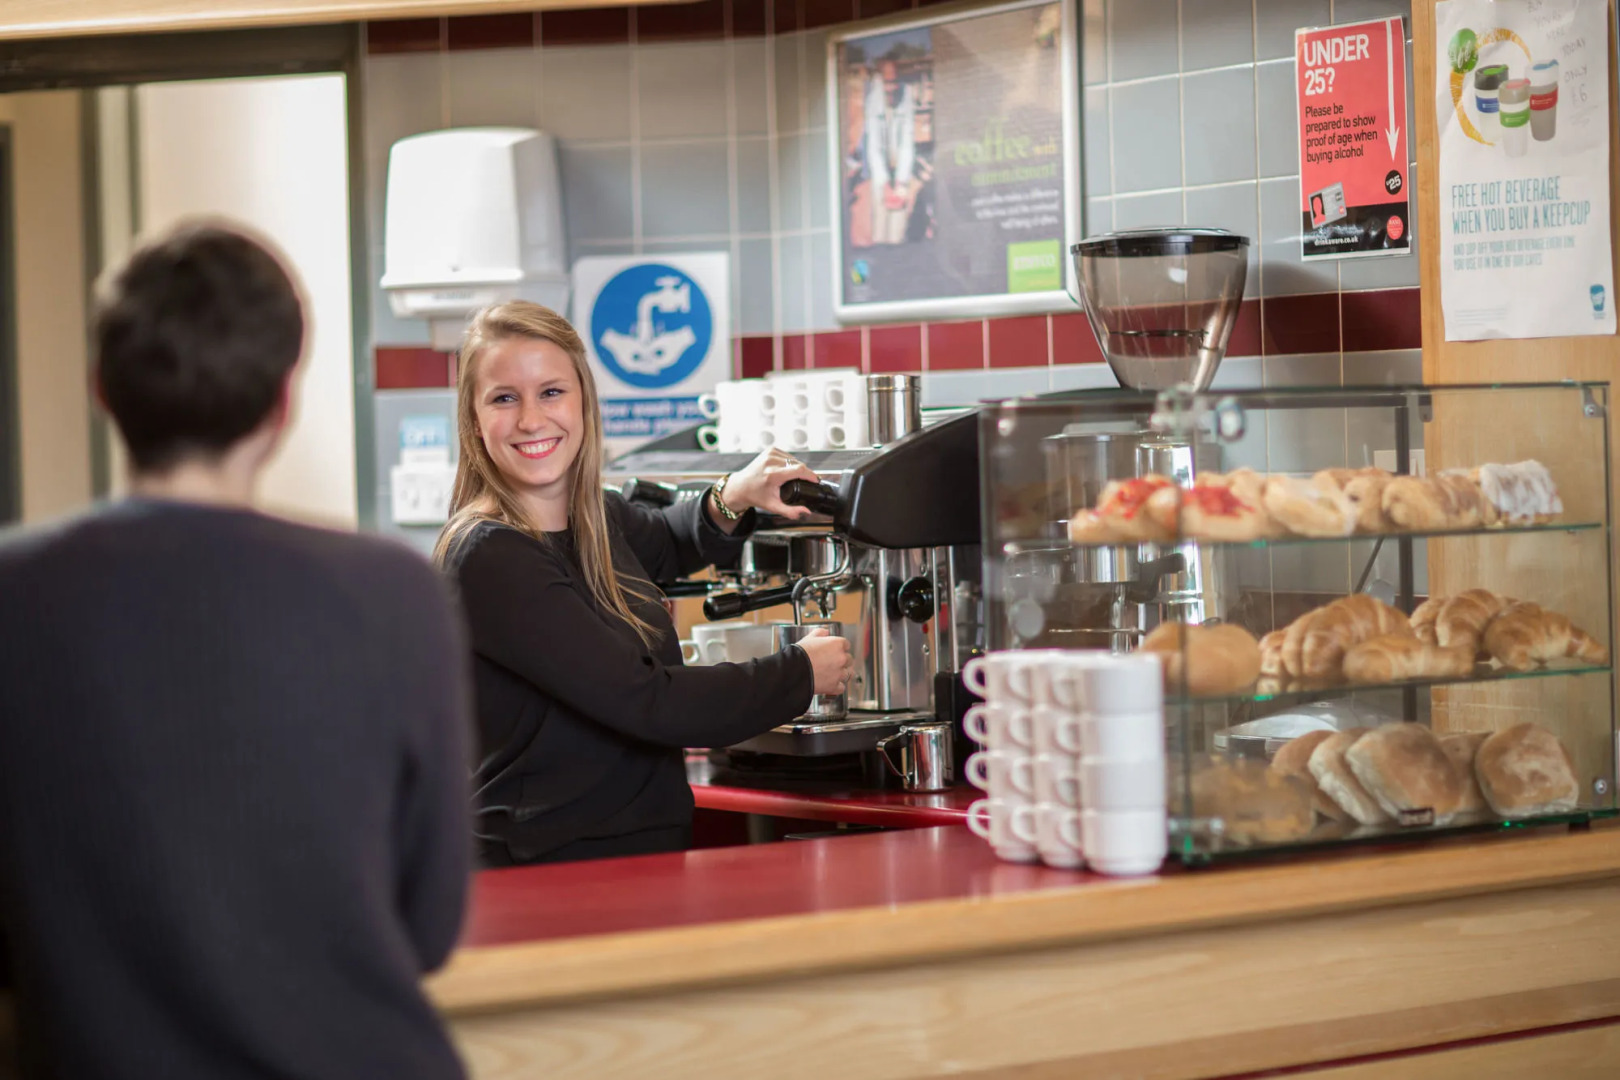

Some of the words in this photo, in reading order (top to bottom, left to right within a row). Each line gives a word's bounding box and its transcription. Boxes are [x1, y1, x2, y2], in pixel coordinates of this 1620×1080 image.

[1304, 33, 1370, 67] UNDER
[1305, 67, 1335, 96] 25?
[1305, 105, 1332, 118] Please
[1333, 103, 1344, 114] be
[1306, 117, 1341, 134] prepared
[1343, 118, 1351, 129] to
[1352, 115, 1376, 127] show
[1306, 131, 1327, 148] proof
[1328, 131, 1337, 145] of
[1337, 134, 1353, 147] age
[1354, 130, 1378, 142] when
[1306, 147, 1333, 164] buying
[1334, 145, 1364, 160] alcohol
[1452, 183, 1477, 209] FREE
[1481, 181, 1501, 206] HOT
[1505, 176, 1561, 204] BEVERAGE
[1452, 209, 1481, 235] WHEN
[1485, 207, 1505, 232] YOU
[1509, 205, 1529, 230] BUY
[1533, 205, 1540, 229] A
[1543, 200, 1591, 228] KEEPCUP
